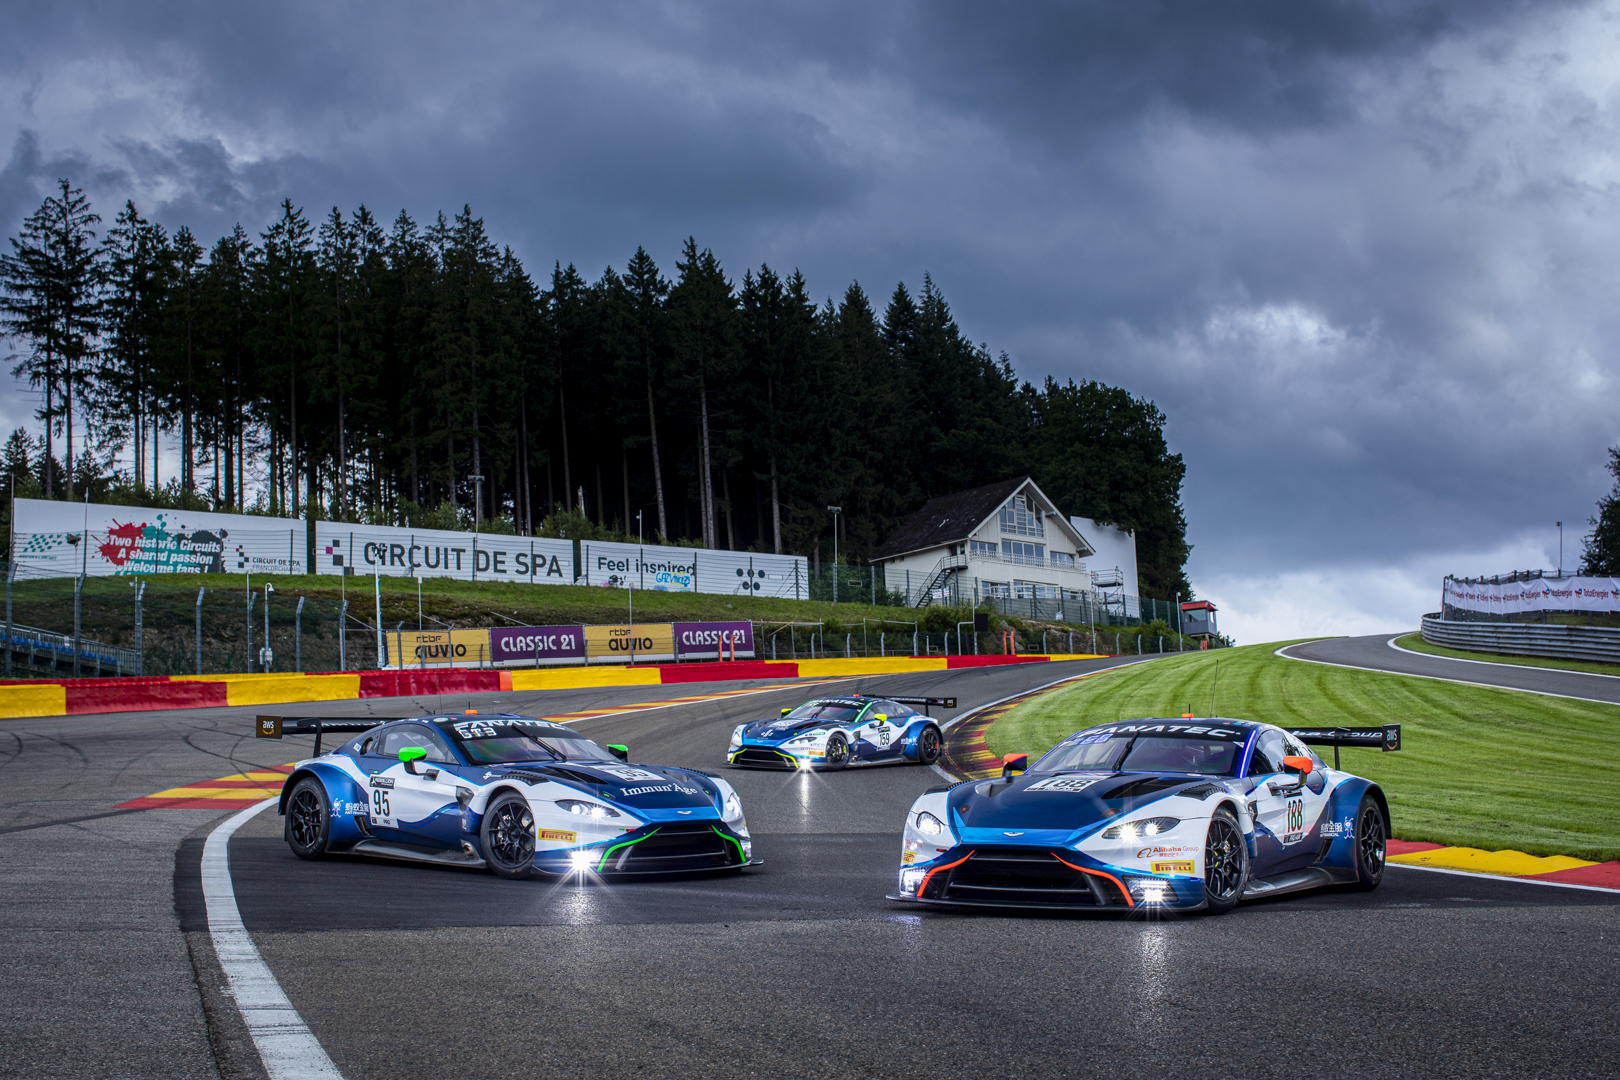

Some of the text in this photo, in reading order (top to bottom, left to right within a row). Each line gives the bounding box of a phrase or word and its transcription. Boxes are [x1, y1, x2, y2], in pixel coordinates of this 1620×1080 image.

[109, 534, 220, 553] Two historic Circuits
[117, 548, 214, 564] A shared passion
[252, 557, 277, 565] CIRCUIT
[288, 559, 301, 567] SPA
[363, 541, 563, 578] CIRCUIT DE SPA
[122, 560, 176, 573] Welcome
[176, 564, 201, 573] fans
[597, 556, 696, 576] Feel inspired
[1583, 588, 1609, 600] TotalEnergies
[416, 635, 442, 643] rtbf
[501, 634, 576, 652] CLASSIC 21
[732, 629, 746, 644] 21
[415, 643, 467, 659] auvio
[608, 637, 653, 651] auvio
[262, 720, 275, 729] aws
[453, 720, 566, 732] FANATEC
[1078, 725, 1236, 738] FANATEC
[879, 732, 890, 746] 159
[1386, 729, 1398, 741] aws
[620, 783, 697, 797] Immun'Age
[373, 789, 390, 817] 95
[1287, 798, 1303, 833] 188
[541, 830, 573, 841] PIRELLI
[1155, 862, 1191, 871] PIRELLI
